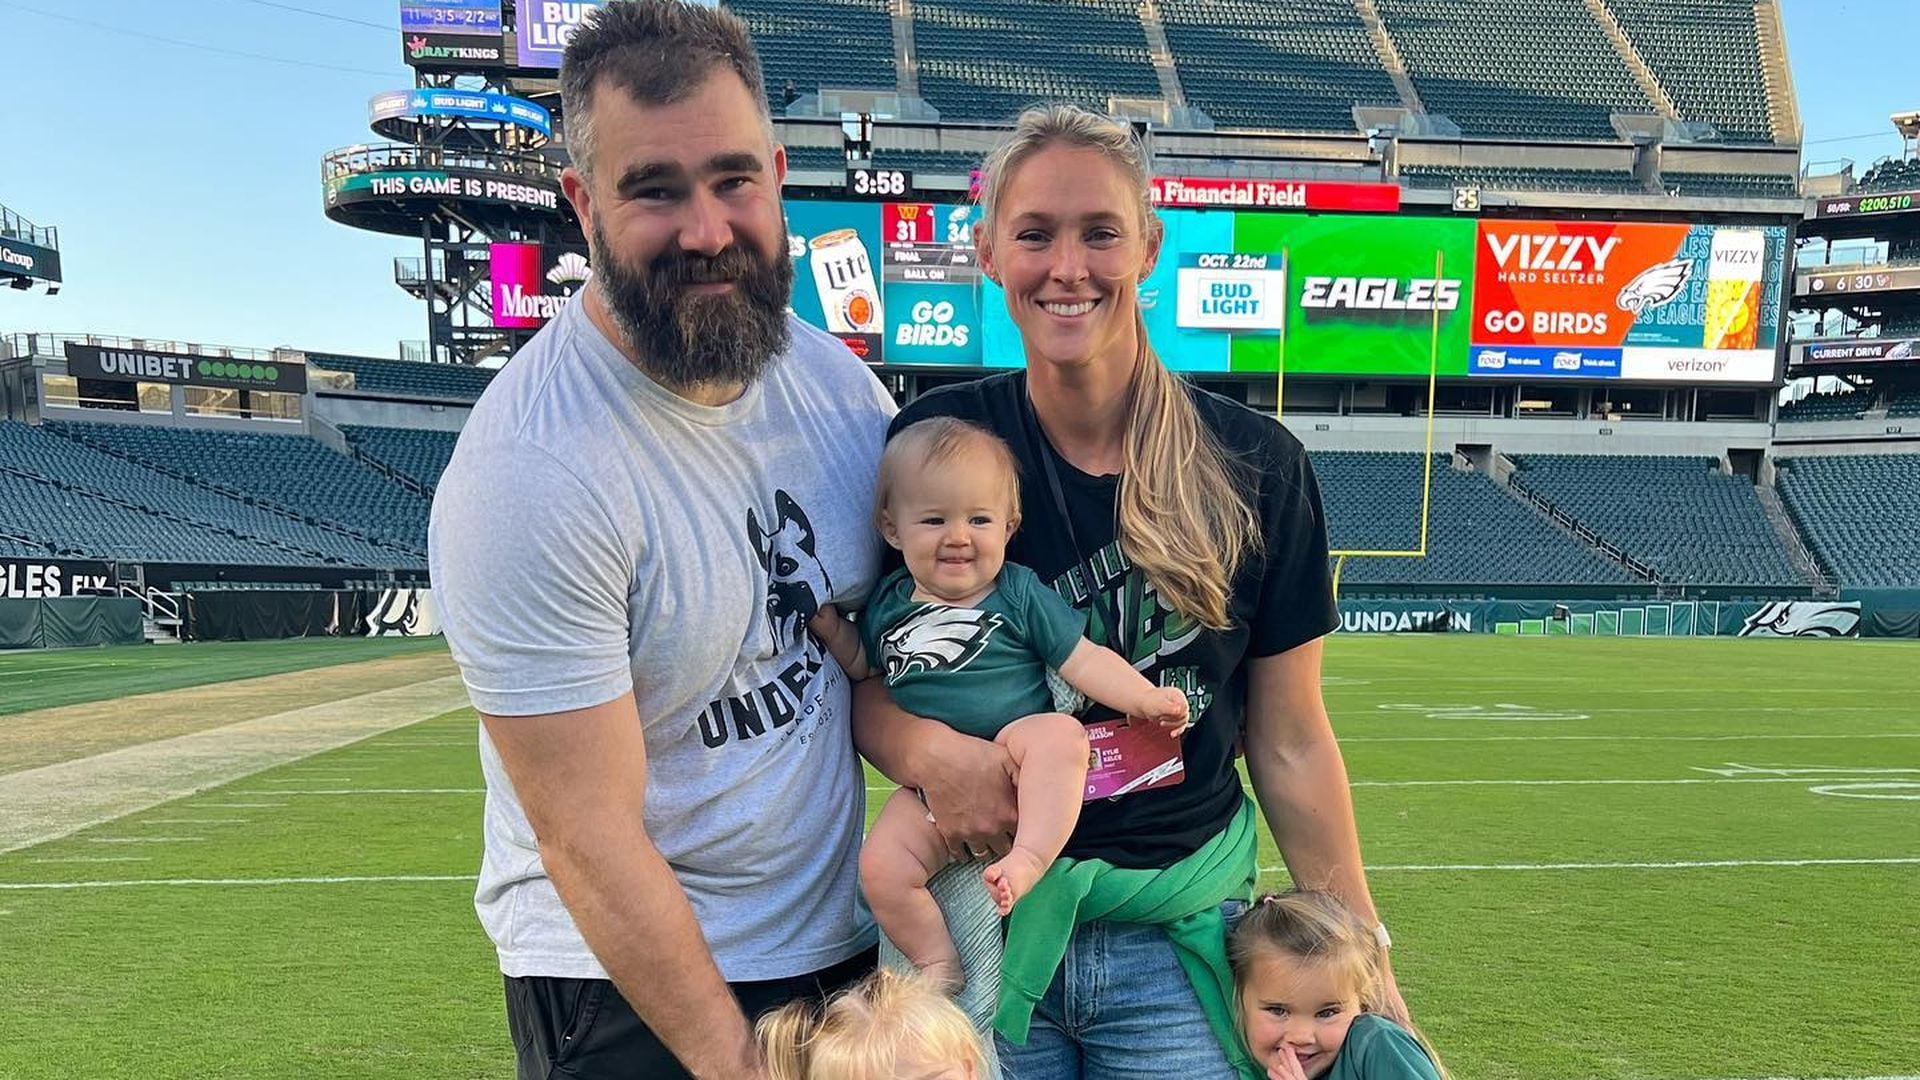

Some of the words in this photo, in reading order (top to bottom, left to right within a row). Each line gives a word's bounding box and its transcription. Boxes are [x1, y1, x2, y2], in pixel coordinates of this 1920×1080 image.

[411, 47, 499, 59] DRAFTKINGS
[434, 96, 455, 106] BUD
[456, 98, 486, 109] LIGHT
[370, 178, 405, 195] THIS
[410, 177, 461, 195] GAME
[465, 180, 481, 196] IS
[854, 170, 905, 194] 3:58
[1164, 181, 1254, 204] Financial
[1256, 184, 1306, 206] Field
[1859, 196, 1911, 212] $200,510
[897, 221, 917, 241] 31
[948, 222, 970, 243] 34
[3, 248, 34, 270] Group
[895, 251, 921, 262] FINAL
[1486, 234, 1617, 271] VIZZY
[1715, 250, 1758, 264] VIZZY
[1199, 254, 1230, 268] OCT.
[1232, 254, 1267, 269] 22nd
[824, 254, 868, 291] Lite
[904, 269, 927, 280] BALL
[930, 269, 945, 280] ON
[1498, 272, 1536, 282] HARD
[1544, 273, 1605, 284] SELTZER
[1836, 278, 1846, 290] 6
[1855, 275, 1873, 289] 30
[1211, 283, 1252, 298] BUD
[1300, 277, 1462, 310] EAGLES
[912, 301, 954, 324] GO
[1202, 300, 1259, 314] LIGHT
[1484, 310, 1525, 333] GO
[1533, 311, 1607, 335] BIRDS
[896, 323, 969, 347] BIRDS
[1813, 348, 1853, 359] CURRENT
[1855, 346, 1882, 357] DRIVE
[100, 351, 193, 379] UNIBET
[1667, 357, 1722, 372] verizon
[1102, 747, 1119, 757] KYLIE
[1103, 753, 1122, 763] KELCE
